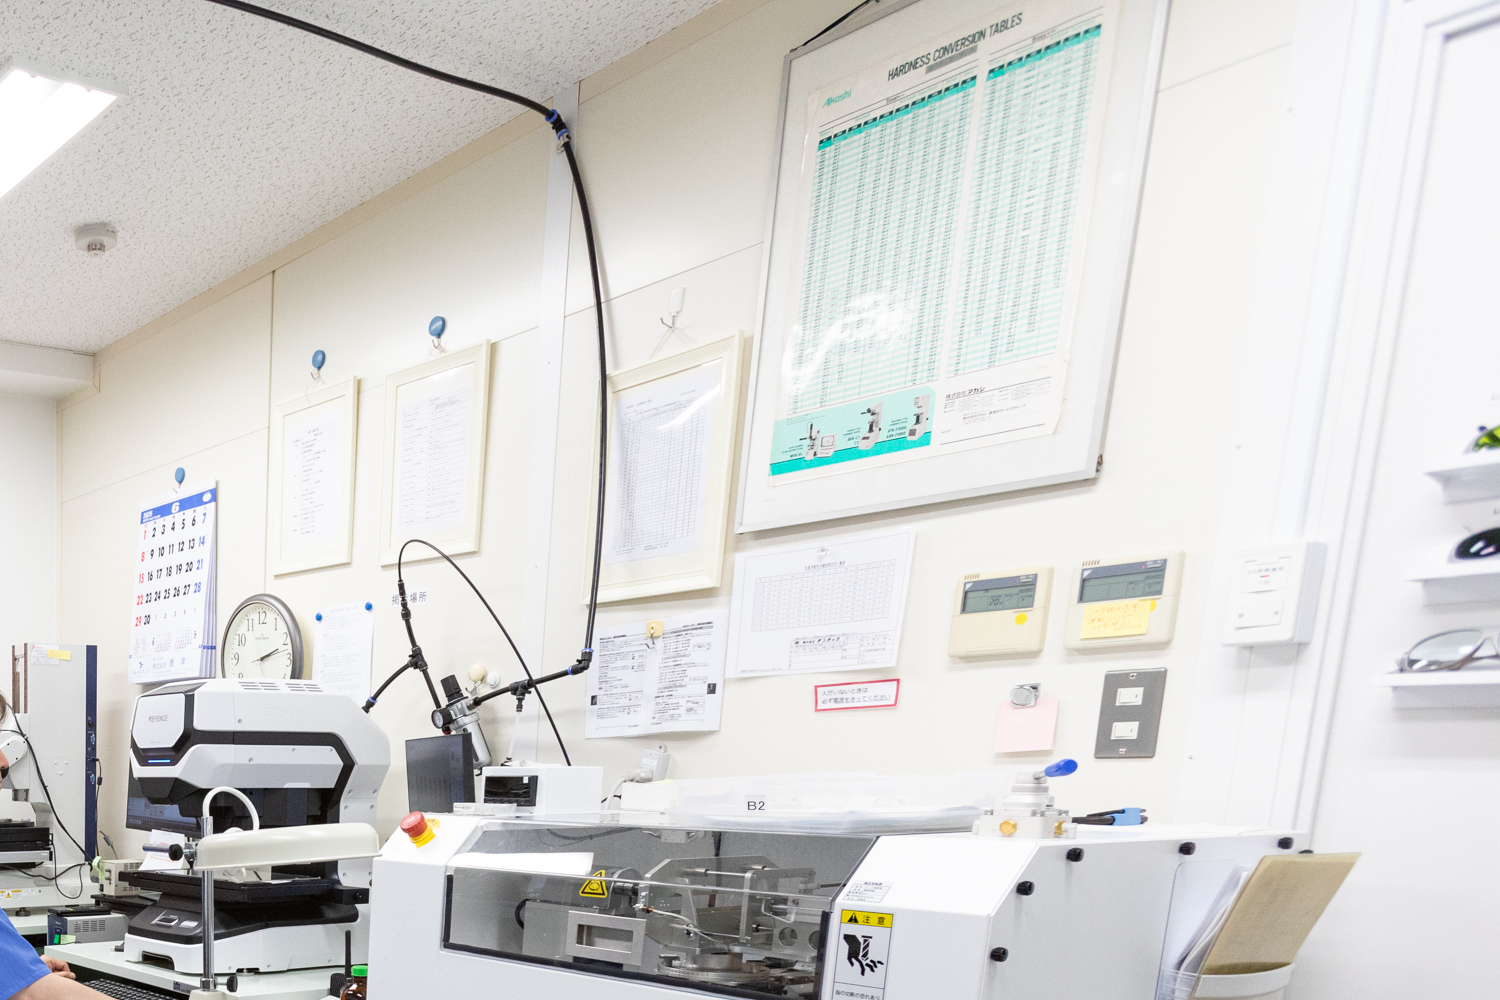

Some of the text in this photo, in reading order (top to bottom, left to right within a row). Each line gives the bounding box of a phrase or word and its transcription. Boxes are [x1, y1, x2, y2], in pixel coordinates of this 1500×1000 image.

[888, 52, 931, 82] HARDNESS
[933, 28, 987, 62] CONVERSION
[989, 12, 1023, 38] TABLES
[822, 88, 852, 109] Akashi
[171, 502, 180, 514] 6
[143, 512, 207, 540] 1 2 3 4 5 6 7
[141, 535, 205, 562] 8 9 10 11 12 13 14
[139, 558, 203, 584] 15 16 17 18 19 20 21
[136, 581, 202, 606] 22 23 24 25 26 27 28
[135, 616, 142, 627] 29
[143, 614, 151, 626] 30
[247, 617, 278, 631] 11 1
[258, 611, 267, 625] 12
[237, 632, 289, 647] 10 2
[234, 652, 292, 668] 9 3
[822, 688, 868, 696] 人がいないときは
[148, 714, 168, 722] KEYENCE
[747, 800, 766, 811] B2
[862, 915, 886, 926] 注意
